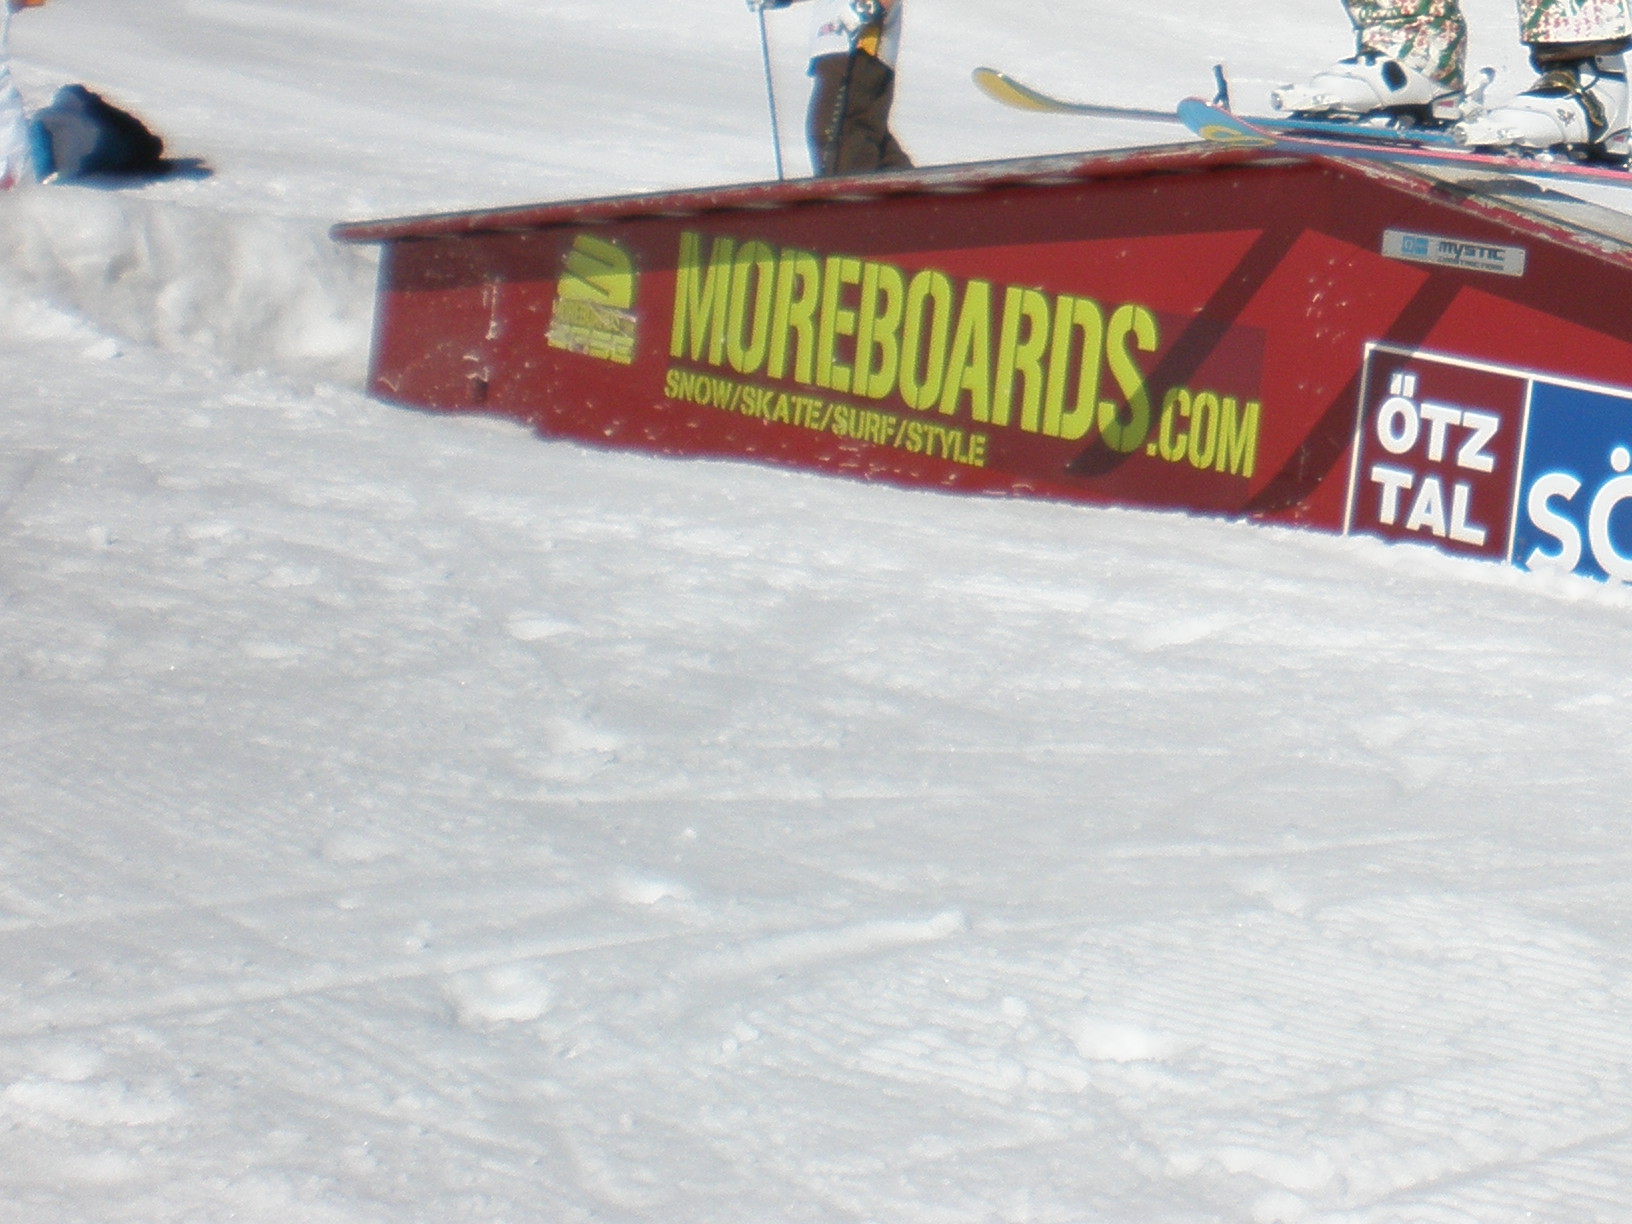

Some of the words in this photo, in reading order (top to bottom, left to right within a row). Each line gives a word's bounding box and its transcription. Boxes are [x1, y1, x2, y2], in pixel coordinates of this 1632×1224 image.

[669, 230, 1261, 478] MOREBOARDS.COM
[663, 369, 988, 468] SNOW/SKATE/SURF/STYLE
[1376, 373, 1499, 473] ÖTZ
[1371, 466, 1486, 547] TAL
